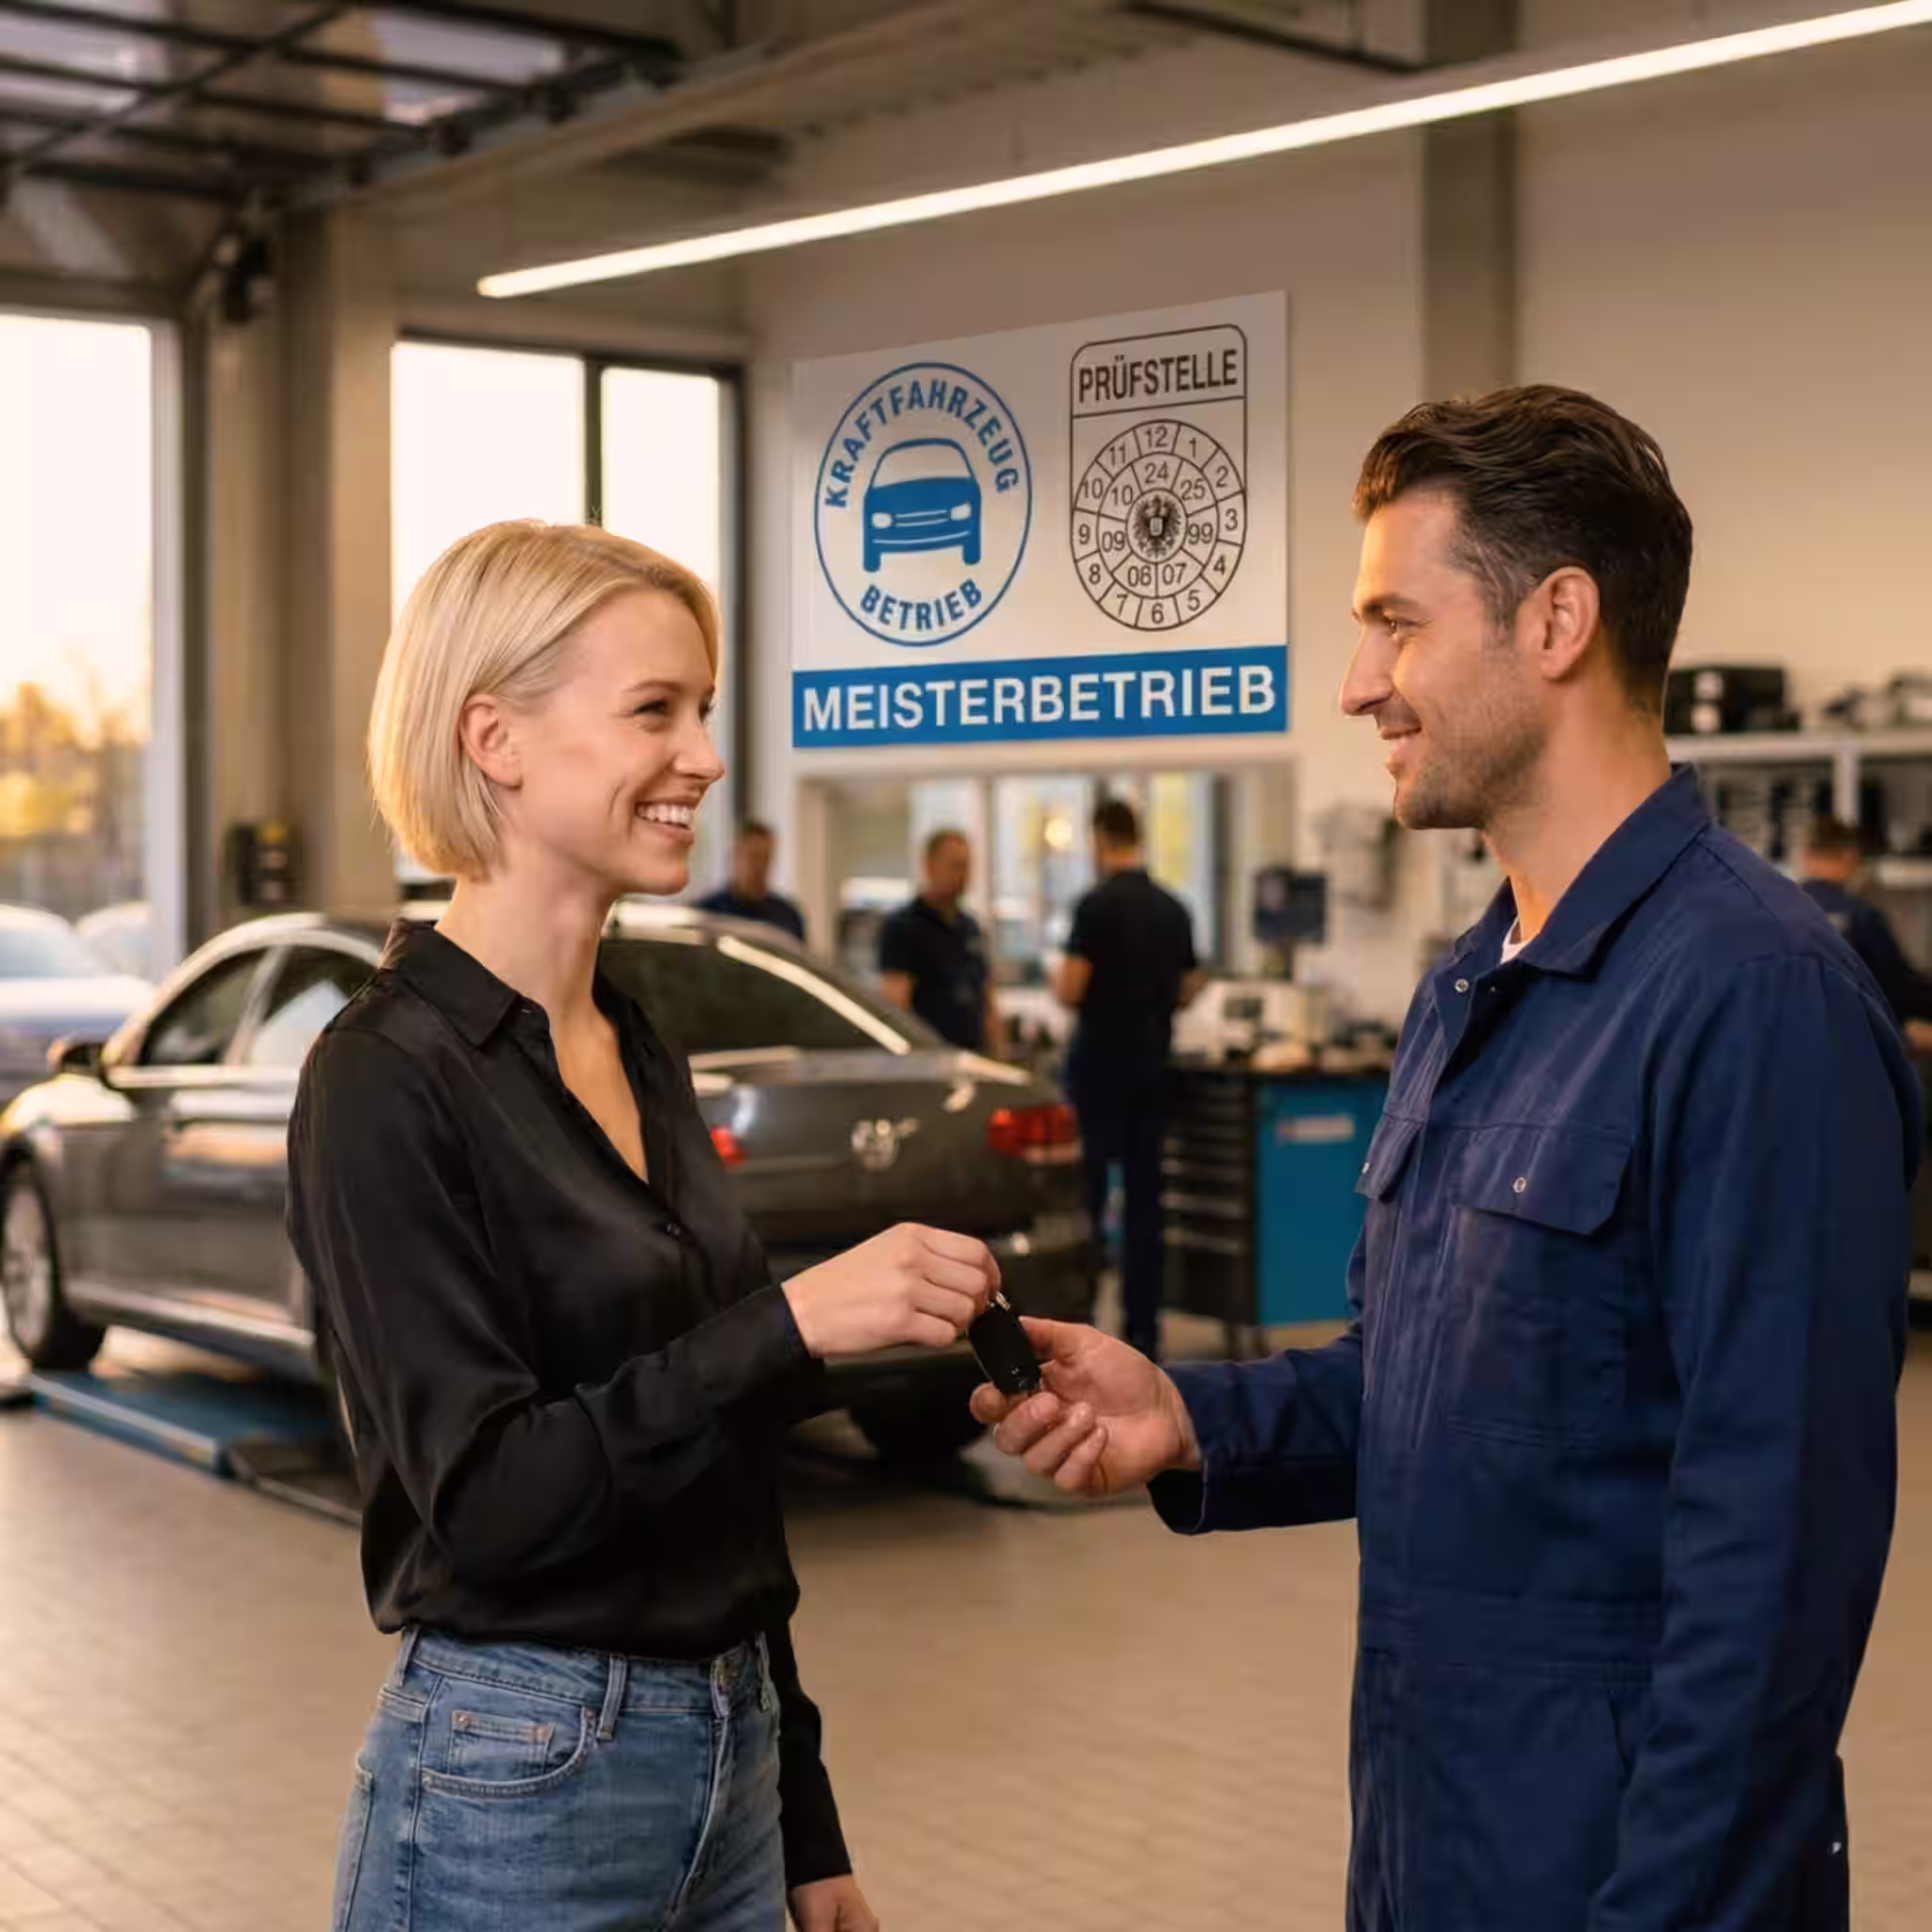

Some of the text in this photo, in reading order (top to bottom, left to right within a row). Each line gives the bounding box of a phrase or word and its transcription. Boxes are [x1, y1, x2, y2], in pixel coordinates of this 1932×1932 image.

[1079, 349, 1238, 403] PRÜFSTELLE
[824, 378, 1019, 508] KRAFTFAHRZEUG
[1143, 425, 1168, 448] 12
[1108, 443, 1126, 466] 11
[1190, 438, 1197, 458] 1
[1144, 461, 1169, 484] 24
[1216, 467, 1229, 488] 2
[1083, 477, 1104, 499] 10
[1111, 484, 1134, 506] 10
[1180, 478, 1206, 501] 25
[1224, 508, 1238, 530] 3
[1078, 524, 1091, 545] 9
[1102, 530, 1125, 553] 09
[1188, 522, 1213, 544] 99
[1089, 563, 1101, 585] 8
[1162, 562, 1187, 585] 07
[1213, 555, 1225, 575] 4
[860, 577, 982, 631] BETRIEB
[1117, 593, 1129, 616] 7
[1188, 590, 1200, 611] 5
[1151, 603, 1164, 624] 6
[803, 665, 1275, 731] MEISTERBETRIEB
